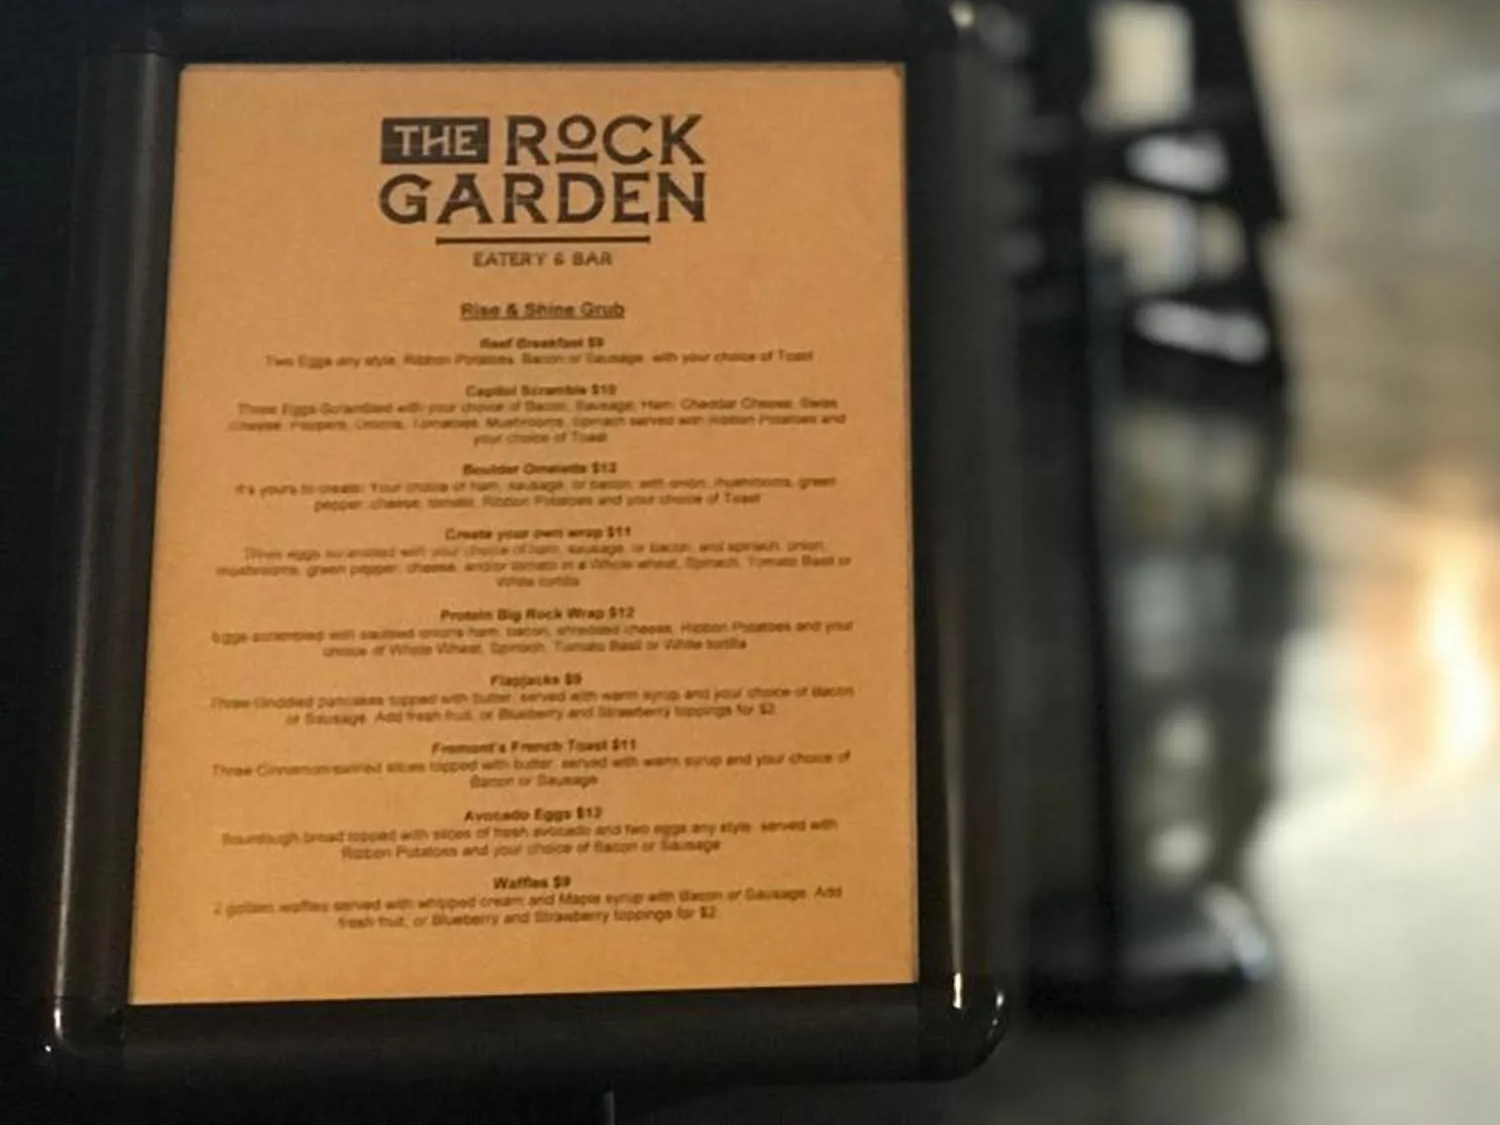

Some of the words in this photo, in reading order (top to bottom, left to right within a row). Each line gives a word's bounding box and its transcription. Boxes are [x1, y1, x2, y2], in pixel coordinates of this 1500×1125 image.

[391, 124, 480, 157] THE
[505, 114, 705, 165] ROCK
[378, 172, 706, 224] GARDEN
[473, 251, 547, 267] EATERY
[571, 251, 613, 266] BAR
[460, 303, 502, 319] Rise
[523, 302, 576, 318] Shine
[579, 301, 626, 318] Grub
